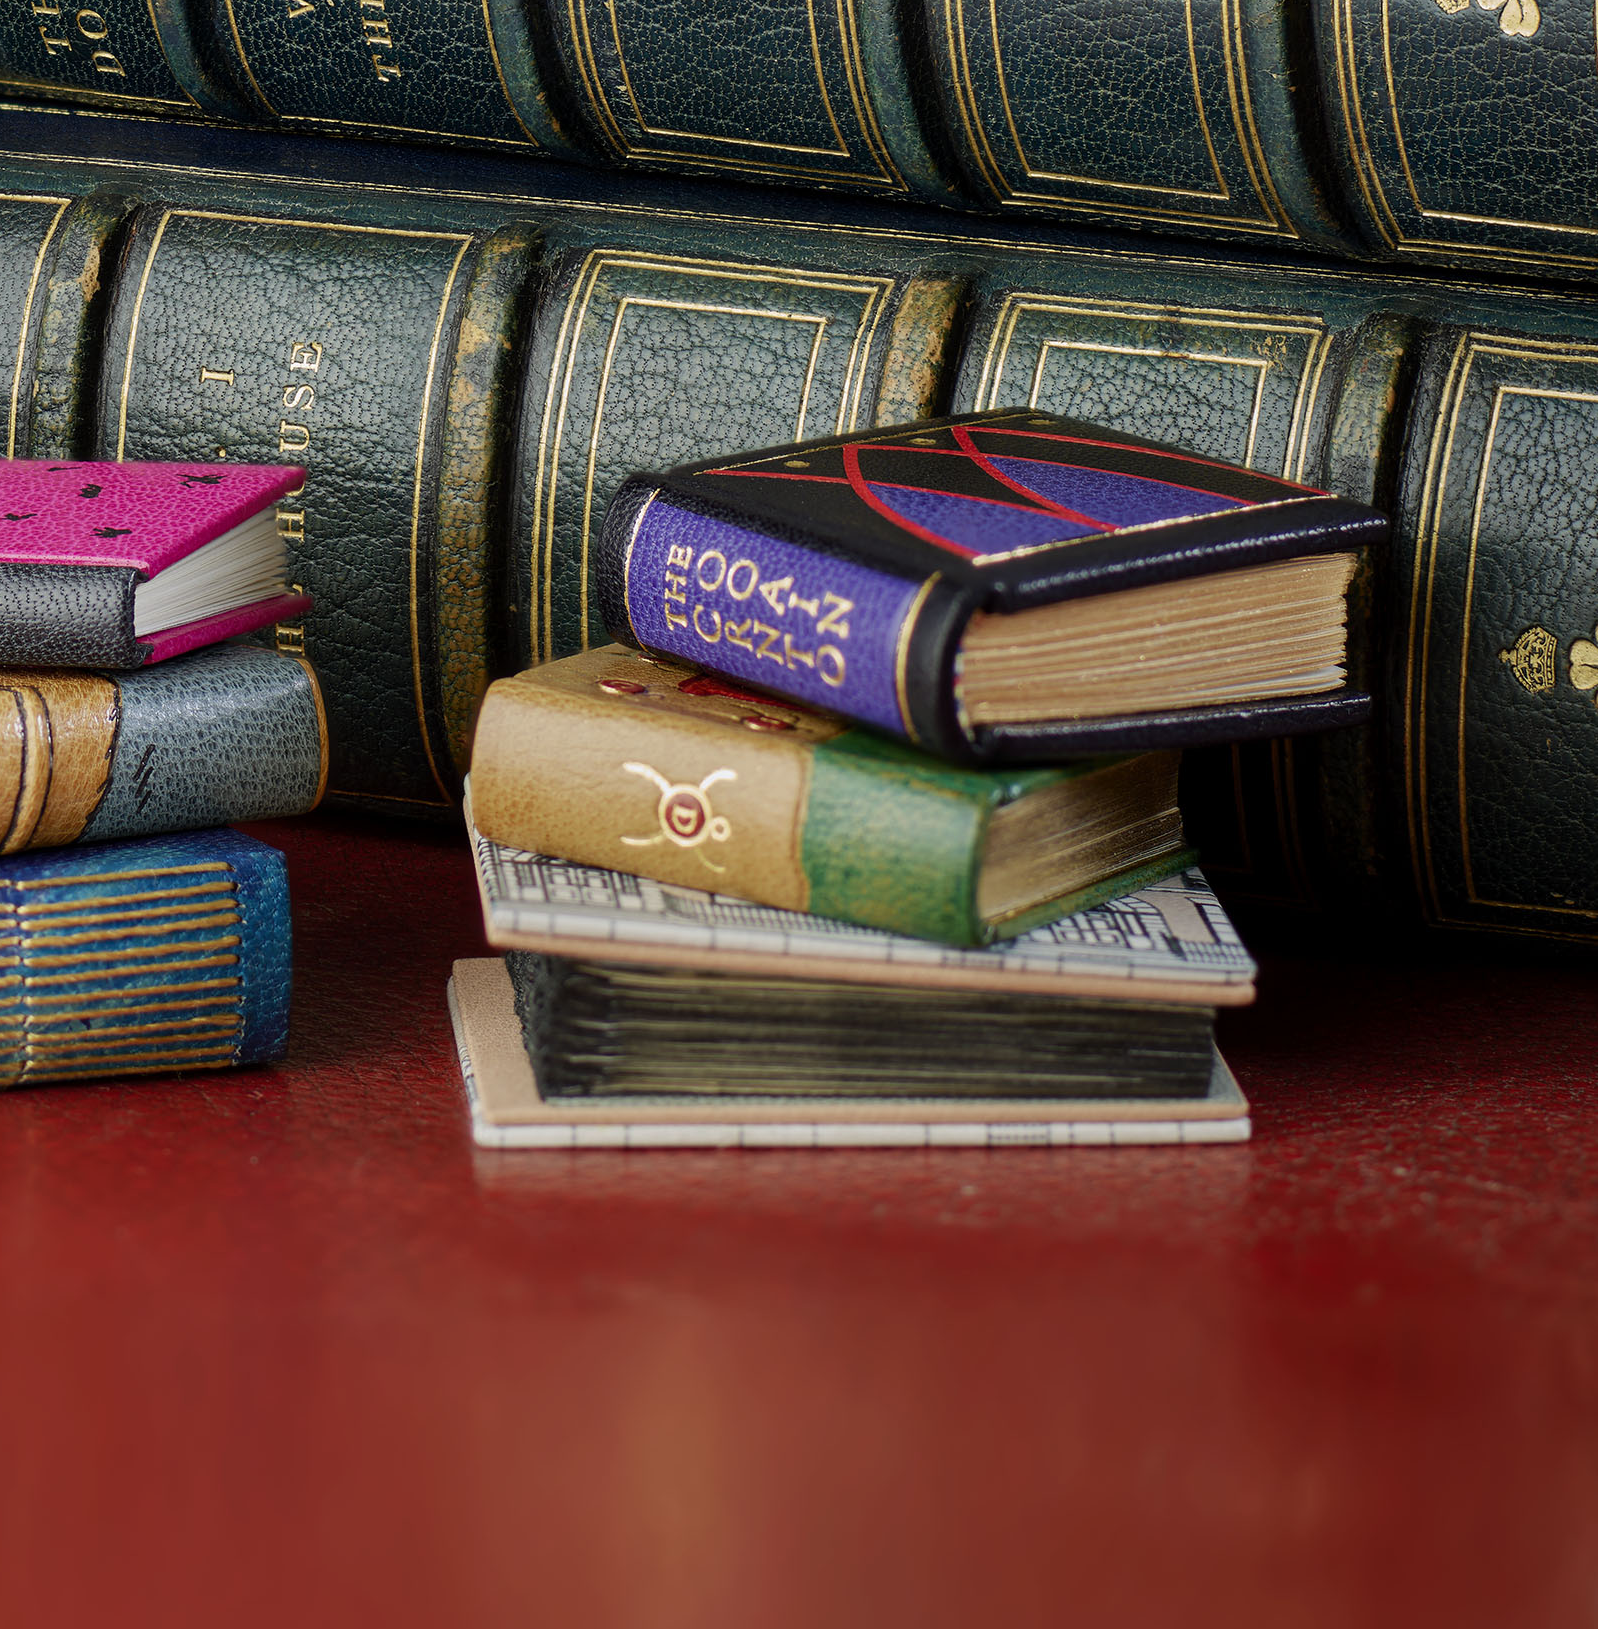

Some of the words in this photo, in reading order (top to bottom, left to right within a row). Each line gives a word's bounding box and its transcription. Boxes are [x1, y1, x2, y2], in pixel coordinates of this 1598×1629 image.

[200, 366, 235, 386] I
[276, 341, 323, 542] HUSE
[664, 544, 694, 631] THE
